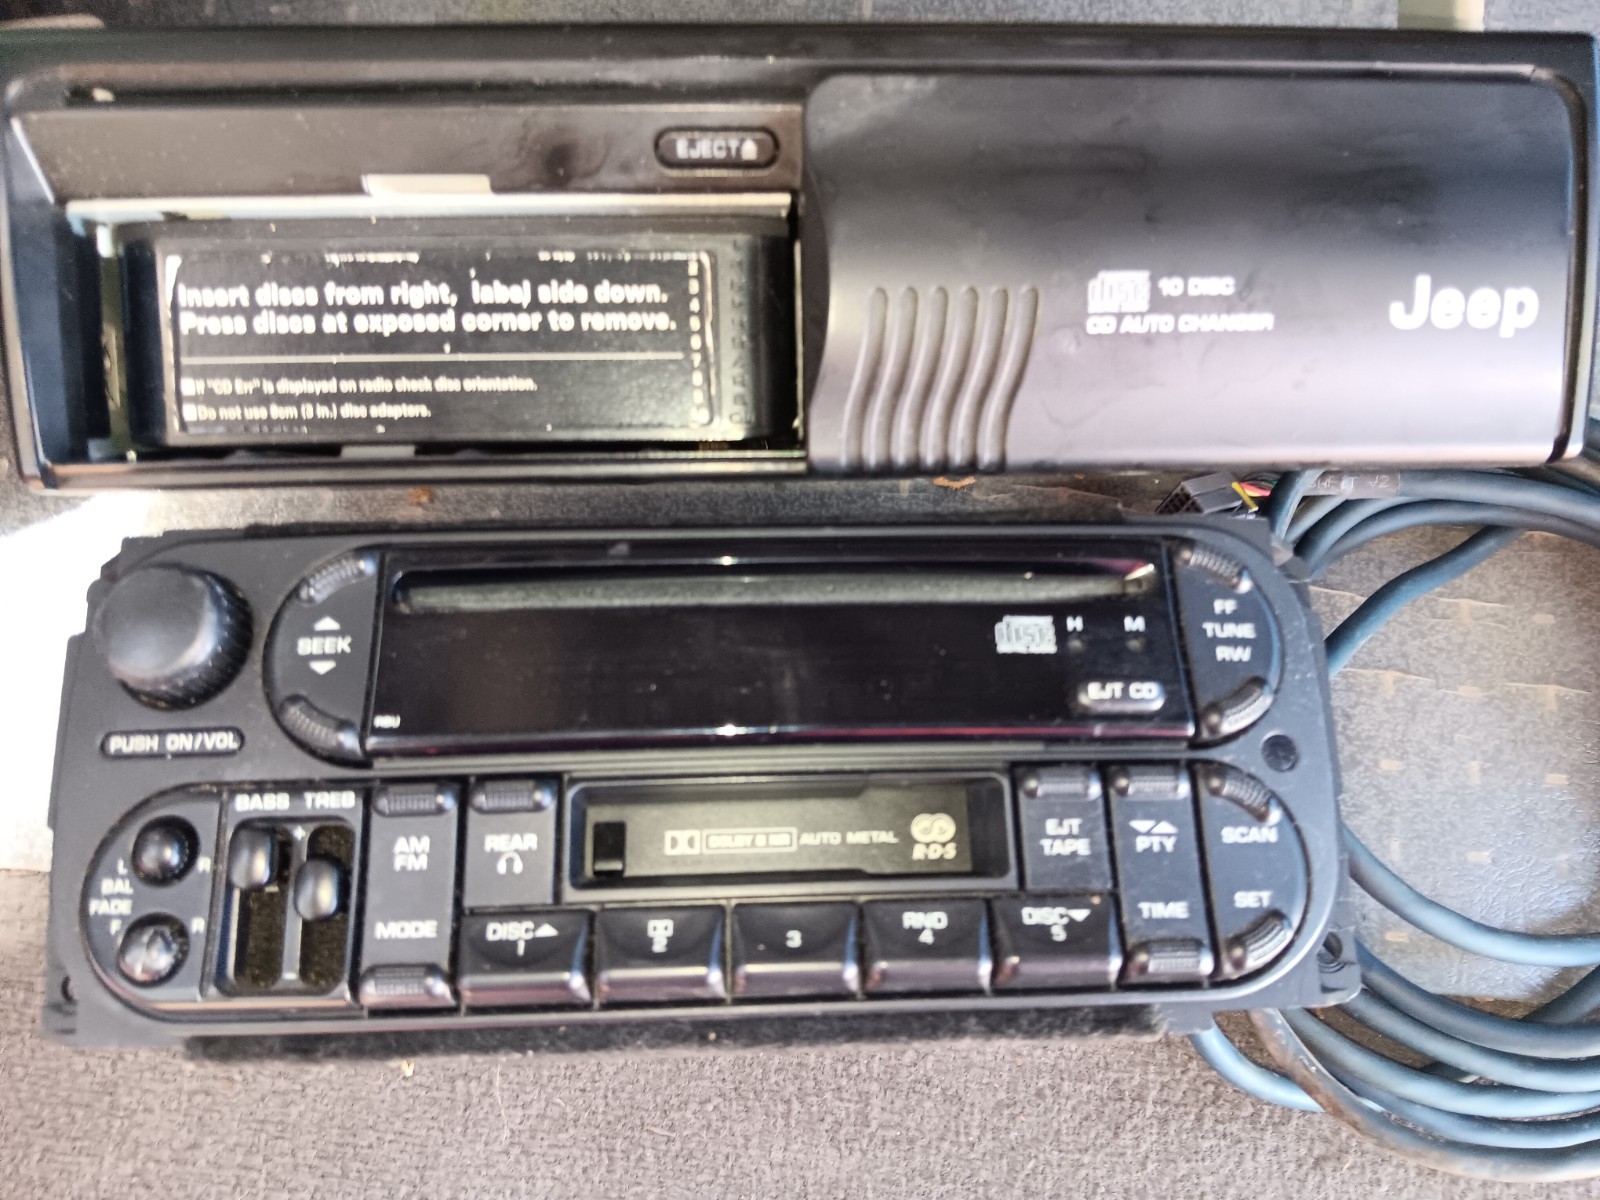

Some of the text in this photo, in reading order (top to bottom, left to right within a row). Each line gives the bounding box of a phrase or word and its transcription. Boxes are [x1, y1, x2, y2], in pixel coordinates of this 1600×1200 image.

[676, 139, 740, 159] EJECT
[178, 279, 668, 309] Insert discs from right, label side down.
[1158, 276, 1236, 296] 10 DISC
[1389, 273, 1539, 338] Jeep
[179, 309, 677, 337] Press discs at exposed corner to remove.
[1086, 312, 1275, 334] CD AUTO CHANGER
[276, 376, 337, 396] displayed
[339, 379, 357, 393] on
[359, 376, 393, 393] radio
[395, 376, 432, 392] check
[219, 405, 242, 420] not
[1214, 599, 1238, 614] FF
[1066, 616, 1083, 631] H
[1124, 616, 1145, 632] M
[1202, 623, 1256, 638] TUNE
[298, 636, 351, 655] SEEK
[1216, 647, 1251, 662] RW
[1087, 682, 1159, 699] EJT CD
[110, 732, 238, 754] PUSH ON/VOL
[235, 793, 290, 811] BASS
[304, 791, 355, 809] TREB
[1046, 818, 1082, 835] EJT
[484, 833, 537, 852] REAR
[799, 830, 899, 845] AUTO METAL
[1136, 836, 1176, 852] PTY
[1221, 827, 1278, 844] SCAN
[393, 835, 430, 854] AM
[1039, 838, 1090, 856] TAPE
[117, 858, 128, 874] L
[197, 856, 211, 873] R
[394, 853, 427, 871] FM
[101, 878, 133, 895] BAL
[88, 899, 132, 916] FADE
[1234, 891, 1273, 908] SET
[1021, 907, 1070, 925] DISC
[1138, 902, 1189, 919] TIME
[110, 919, 122, 935] F
[191, 917, 205, 933] R
[902, 911, 948, 929] RND
[375, 919, 437, 940] MODE
[486, 921, 534, 941] DISC
[918, 929, 934, 944] 4
[1051, 924, 1067, 941] 5
[517, 939, 525, 956] 1
[786, 930, 802, 948] 3
